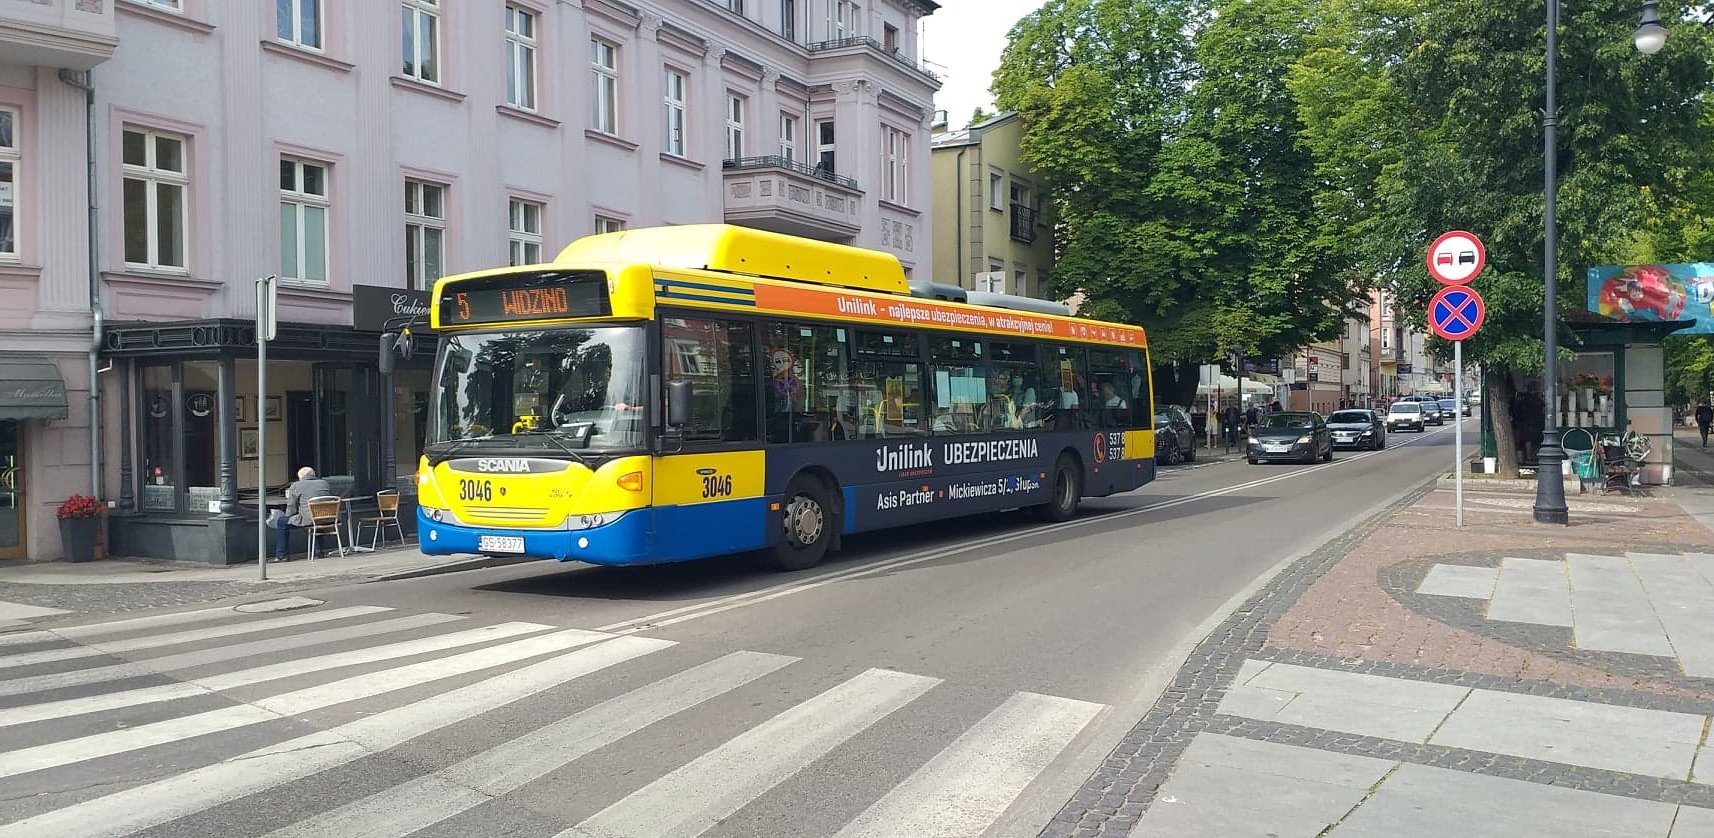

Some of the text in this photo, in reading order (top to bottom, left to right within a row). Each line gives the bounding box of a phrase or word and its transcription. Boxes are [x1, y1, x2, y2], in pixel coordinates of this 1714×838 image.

[455, 287, 568, 320] 5 WIDZINO
[837, 296, 877, 315] Unilink
[888, 303, 930, 323] najlepsze
[931, 307, 988, 328] ubezpieczenia,
[988, 316, 995, 327] w
[996, 316, 1034, 334] atrakcyjnej
[1034, 320, 1053, 333] cenie!
[1109, 432, 1120, 445] 537
[876, 442, 933, 472] Unilink
[944, 438, 1038, 464] UBEZPIECZENIA
[1109, 447, 1120, 460] 537
[477, 459, 530, 472] SCANIA
[460, 479, 492, 501] 3046
[702, 474, 732, 498] 3046
[877, 491, 898, 510] Asis
[900, 490, 934, 506] Partner
[949, 481, 997, 500] Mickiewicza
[483, 536, 495, 547] GS
